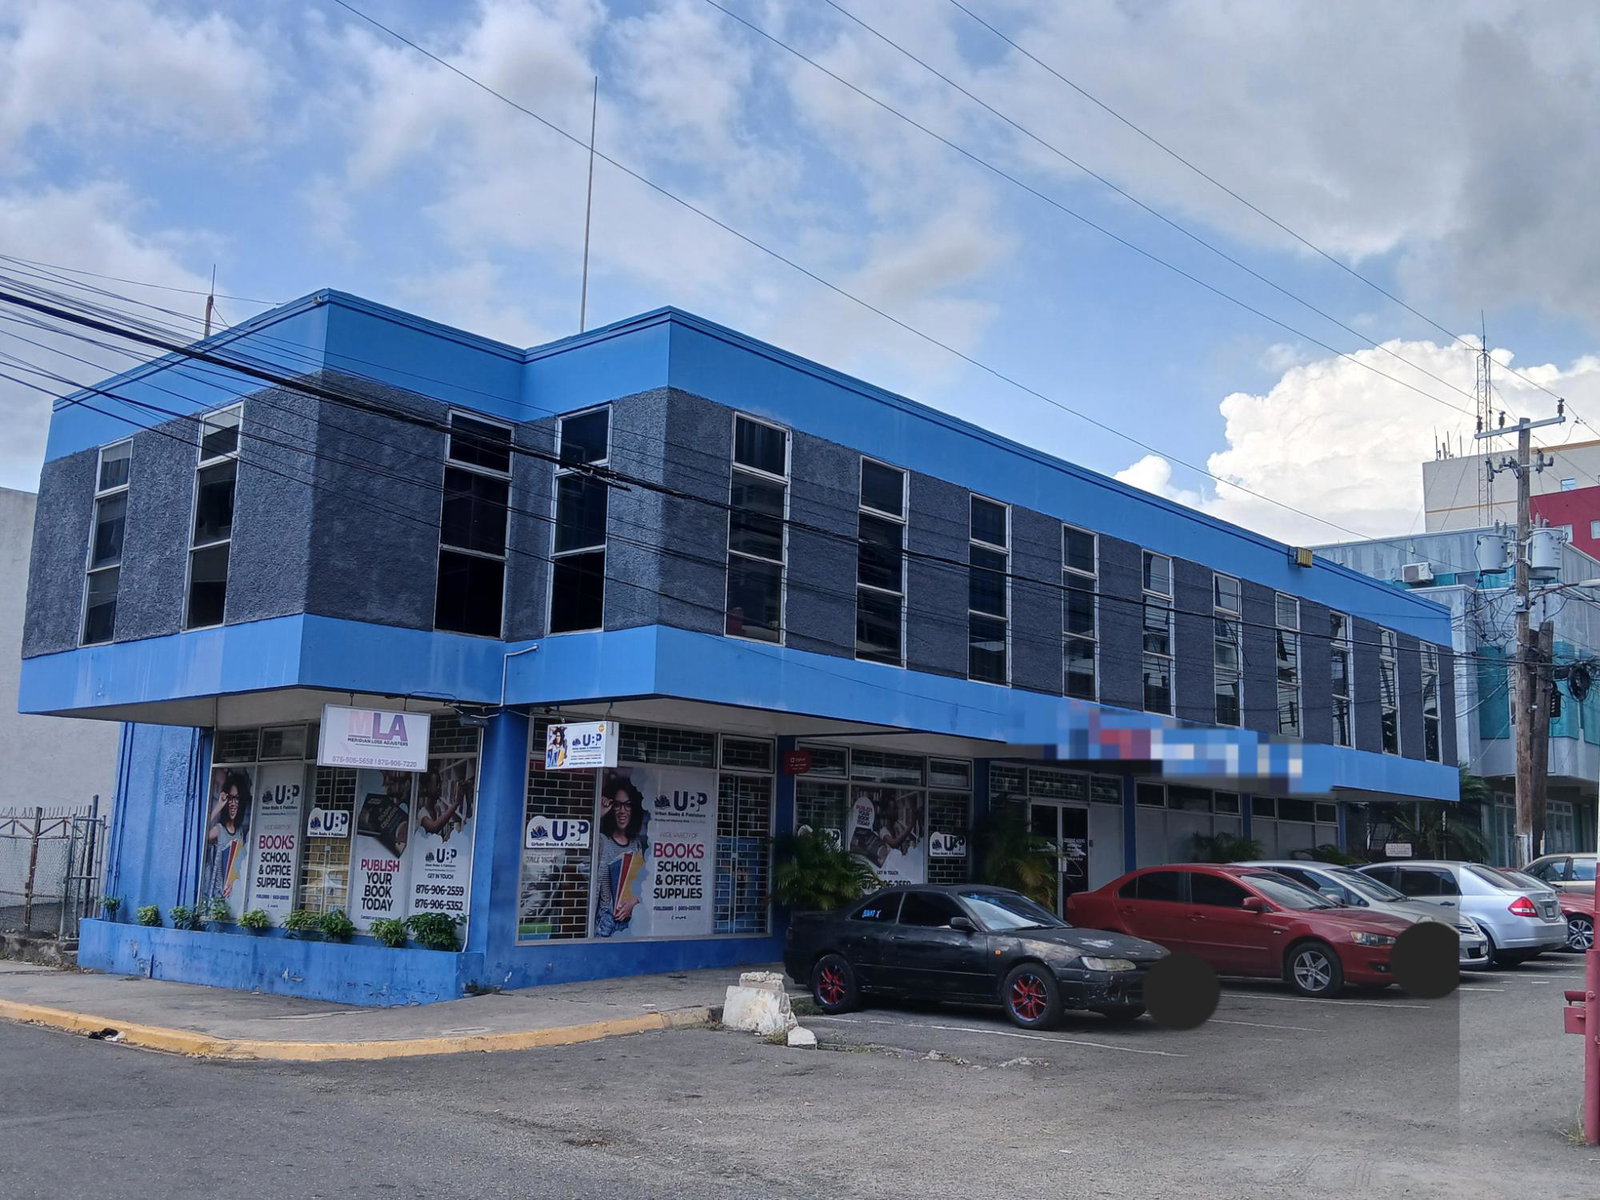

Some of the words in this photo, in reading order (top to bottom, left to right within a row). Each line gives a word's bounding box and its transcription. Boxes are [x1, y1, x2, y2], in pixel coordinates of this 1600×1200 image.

[348, 710, 408, 741] MLA
[552, 820, 589, 841] UBP
[258, 834, 295, 850] BOOKS
[260, 851, 291, 863] SCHOOL
[653, 842, 705, 859] BOOKS
[258, 864, 264, 876] &
[265, 864, 292, 876] OFFICE
[360, 858, 400, 873] PUBLISH
[657, 860, 701, 873] SCHOOL
[256, 876, 292, 889] SUPPLIES
[366, 871, 393, 885] YOUR
[655, 874, 663, 886] &
[665, 874, 702, 886] OFFICE
[364, 885, 393, 899] BOOK
[415, 884, 464, 896] 876-906-2559
[653, 887, 703, 900] SUPPLIES
[361, 897, 394, 912] TODAY
[414, 898, 463, 911] 876-906-5352
